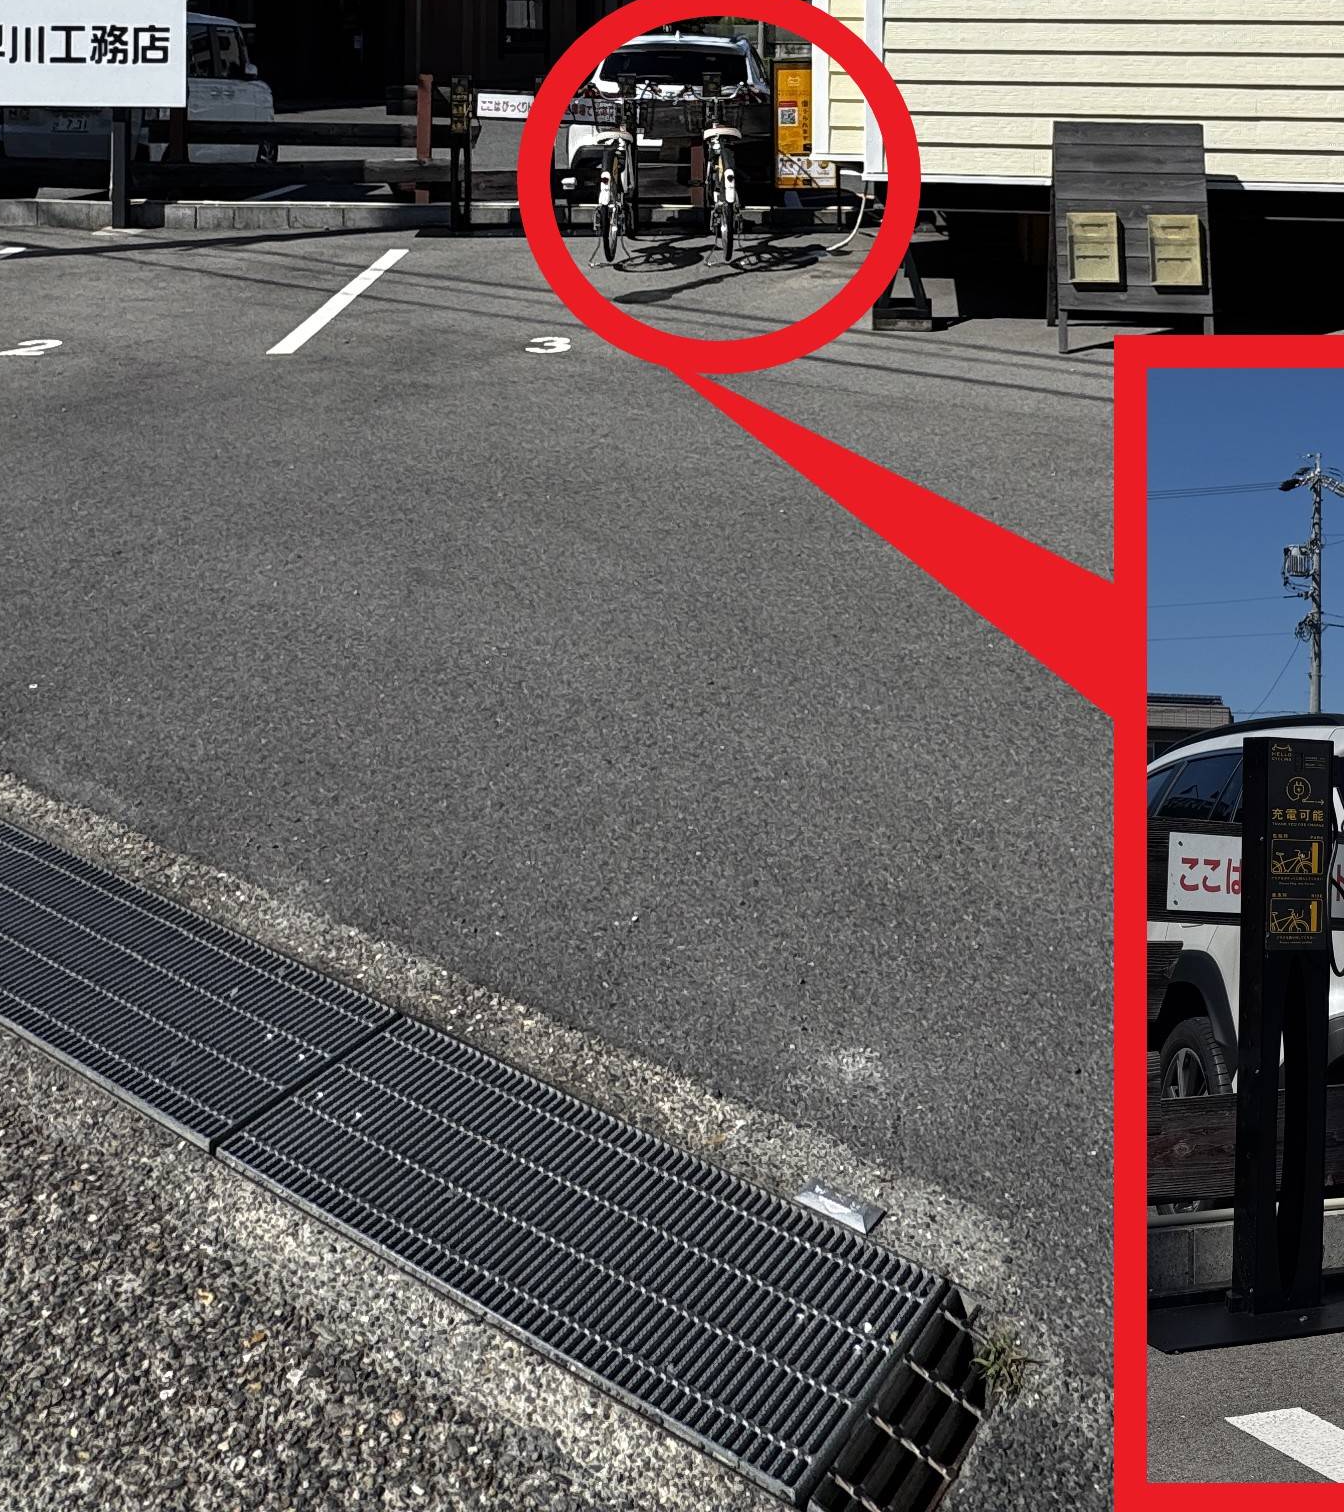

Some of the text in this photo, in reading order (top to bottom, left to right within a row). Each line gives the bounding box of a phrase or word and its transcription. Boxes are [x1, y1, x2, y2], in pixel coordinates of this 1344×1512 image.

[525, 336, 572, 354] 3
[1272, 808, 1324, 822] 充電可能
